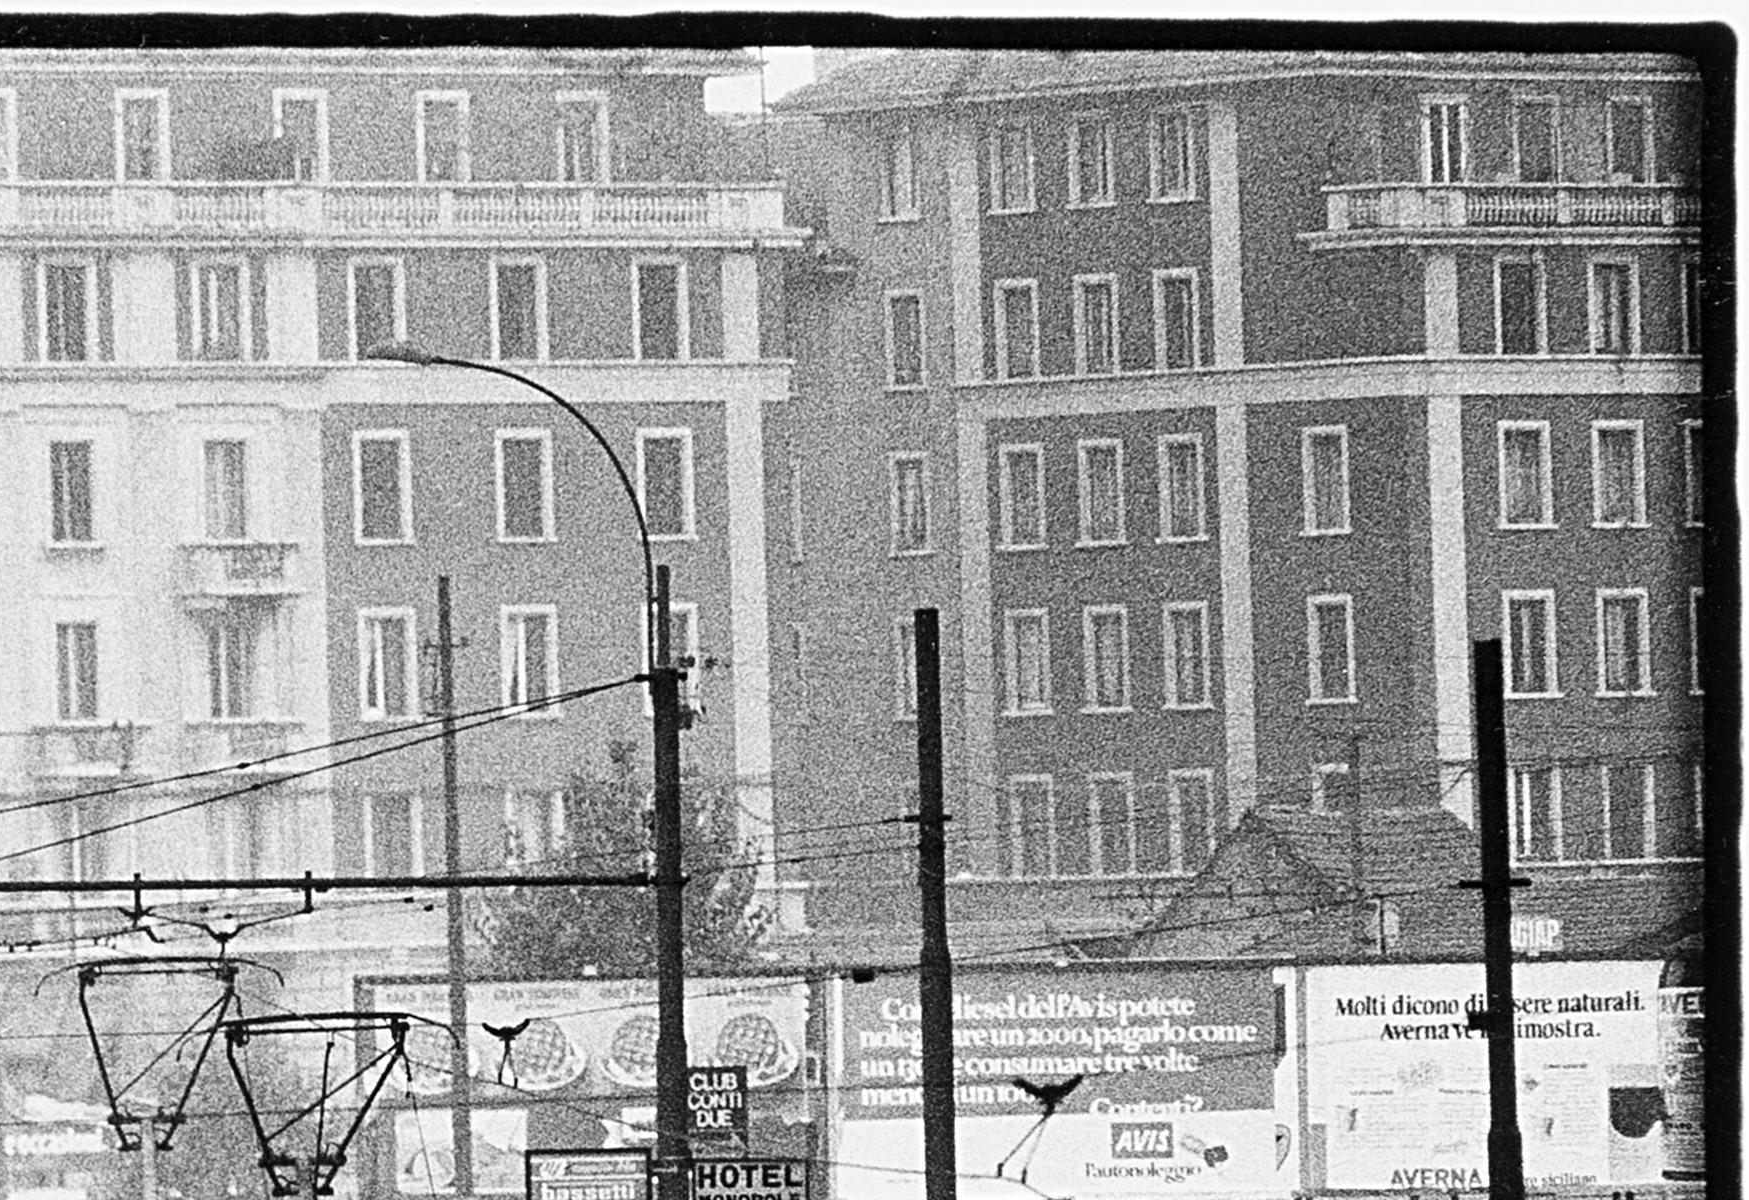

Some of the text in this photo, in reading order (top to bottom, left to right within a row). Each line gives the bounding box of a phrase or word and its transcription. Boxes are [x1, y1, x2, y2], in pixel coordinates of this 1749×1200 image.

[1120, 997, 1195, 1026] potete
[1335, 991, 1646, 1016] Molti dicono di sere naturali.
[1094, 1019, 1186, 1052] pagarlo
[1188, 1023, 1258, 1042] come
[1380, 1022, 1450, 1041] Averna
[1516, 1017, 1602, 1038] imostra.
[859, 1059, 894, 1077] un
[964, 1056, 1102, 1076] consumare
[1138, 1047, 1201, 1072] volte
[689, 1072, 738, 1092] CLUB
[687, 1091, 743, 1110] CONTI
[696, 1109, 734, 1128] DUE
[1114, 1129, 1171, 1153] AVIS
[698, 1164, 803, 1189] HOTEL
[1390, 1168, 1483, 1190] AVERNA
